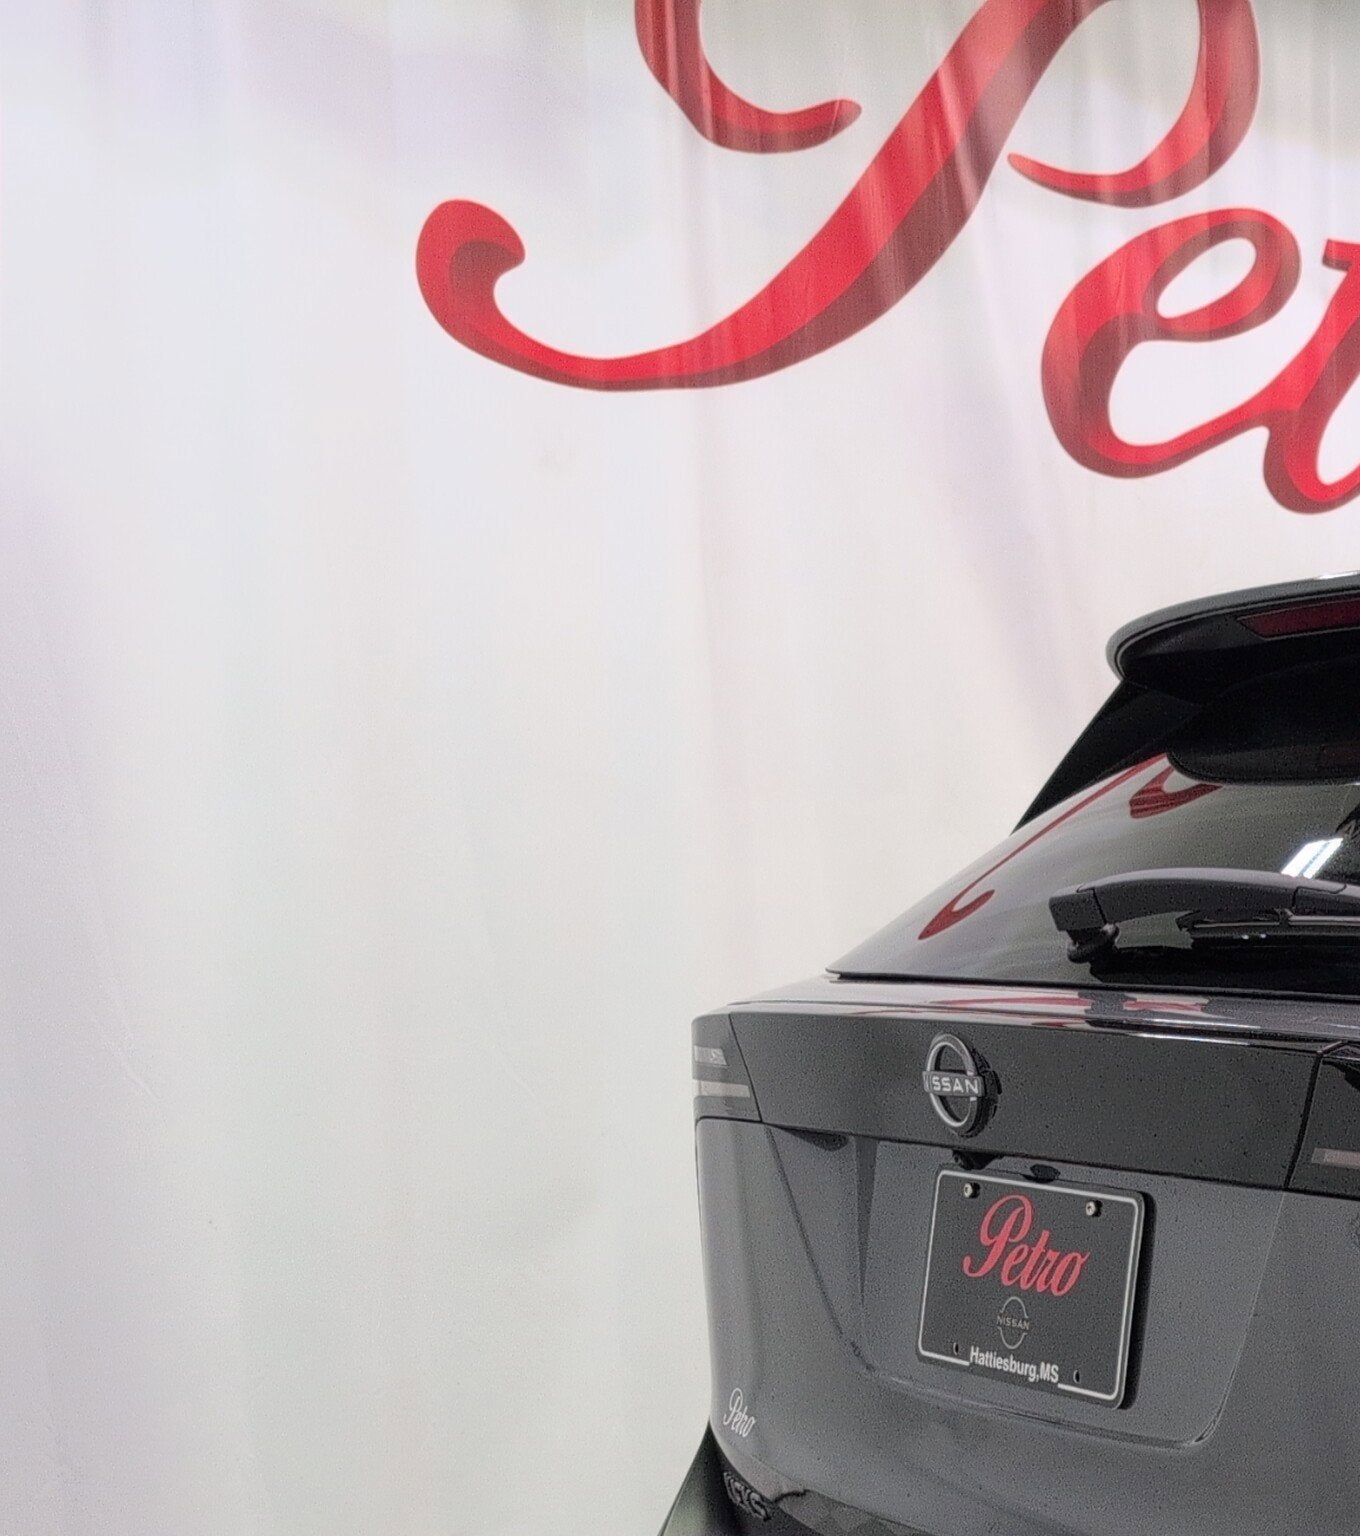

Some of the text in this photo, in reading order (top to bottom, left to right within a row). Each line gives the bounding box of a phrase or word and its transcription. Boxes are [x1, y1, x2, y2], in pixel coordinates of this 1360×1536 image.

[926, 1075, 979, 1094] SSAN
[961, 1193, 1091, 1297] Petro
[996, 1314, 1030, 1332] NISSAN
[723, 1387, 757, 1438] Petro
